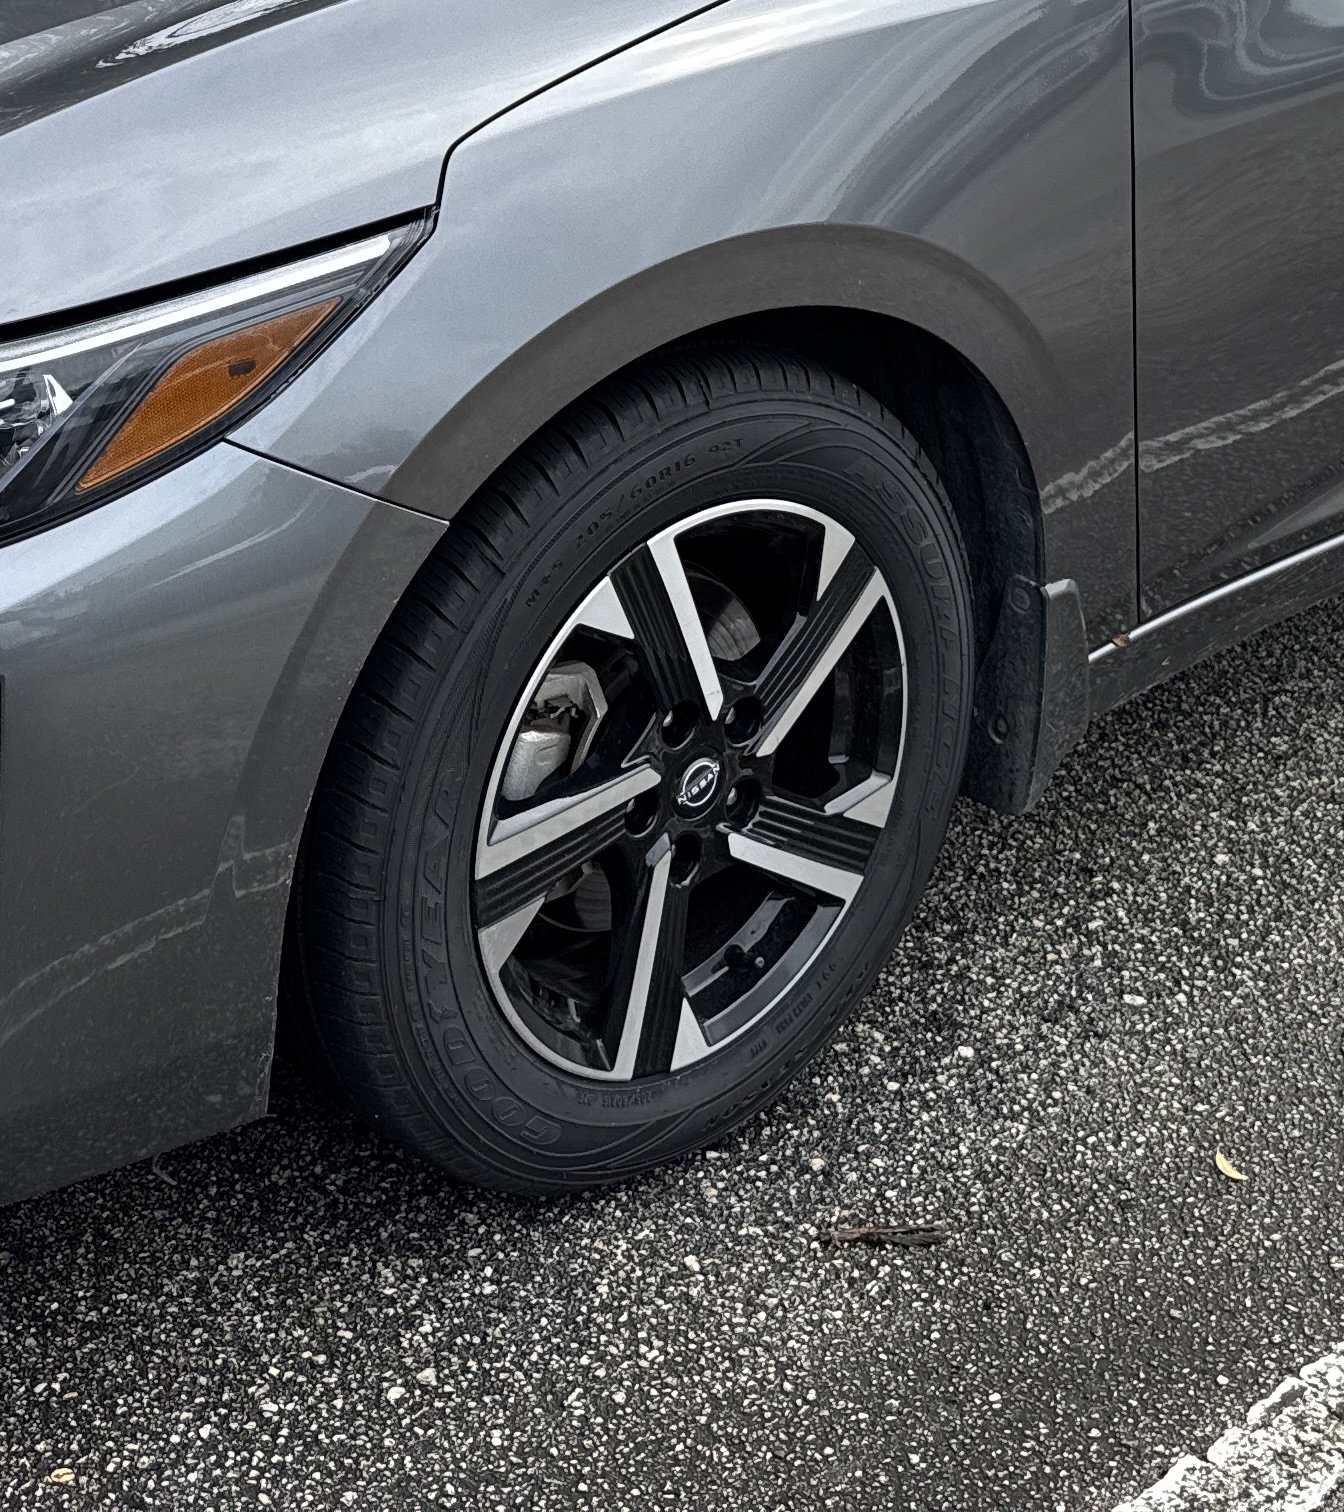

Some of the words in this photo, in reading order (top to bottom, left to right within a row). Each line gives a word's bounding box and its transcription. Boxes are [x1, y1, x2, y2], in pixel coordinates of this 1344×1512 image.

[575, 453, 697, 550] 205/60R16
[708, 438, 744, 455] 92T
[677, 760, 721, 806] NISSAN
[415, 771, 563, 1146] GOODYEAR
